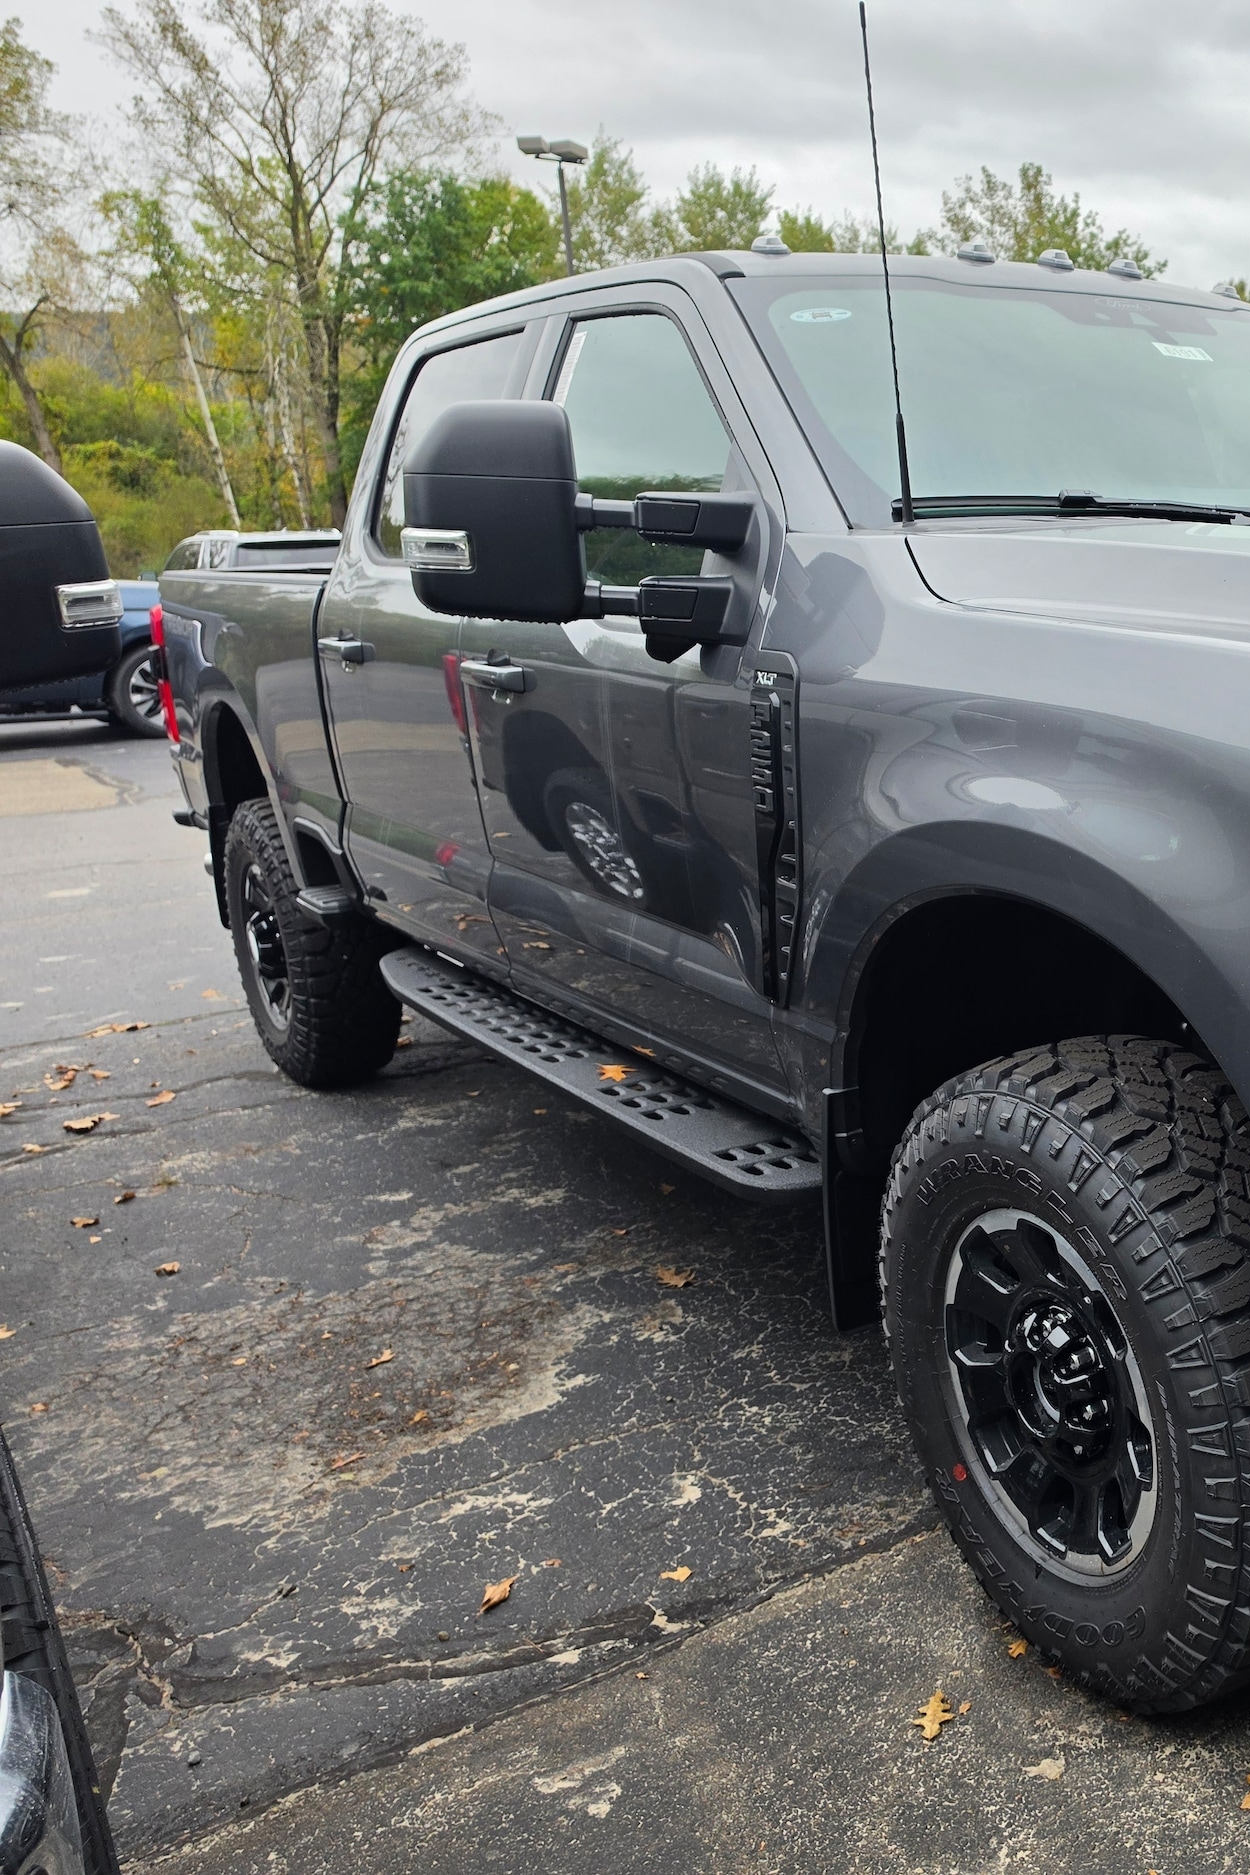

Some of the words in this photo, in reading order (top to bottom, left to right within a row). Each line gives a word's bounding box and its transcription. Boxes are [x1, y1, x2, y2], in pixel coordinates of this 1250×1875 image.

[756, 671, 777, 686] XLT
[916, 1153, 1130, 1302] WRANGLER
[935, 1467, 1147, 1647] GOODYEAR
